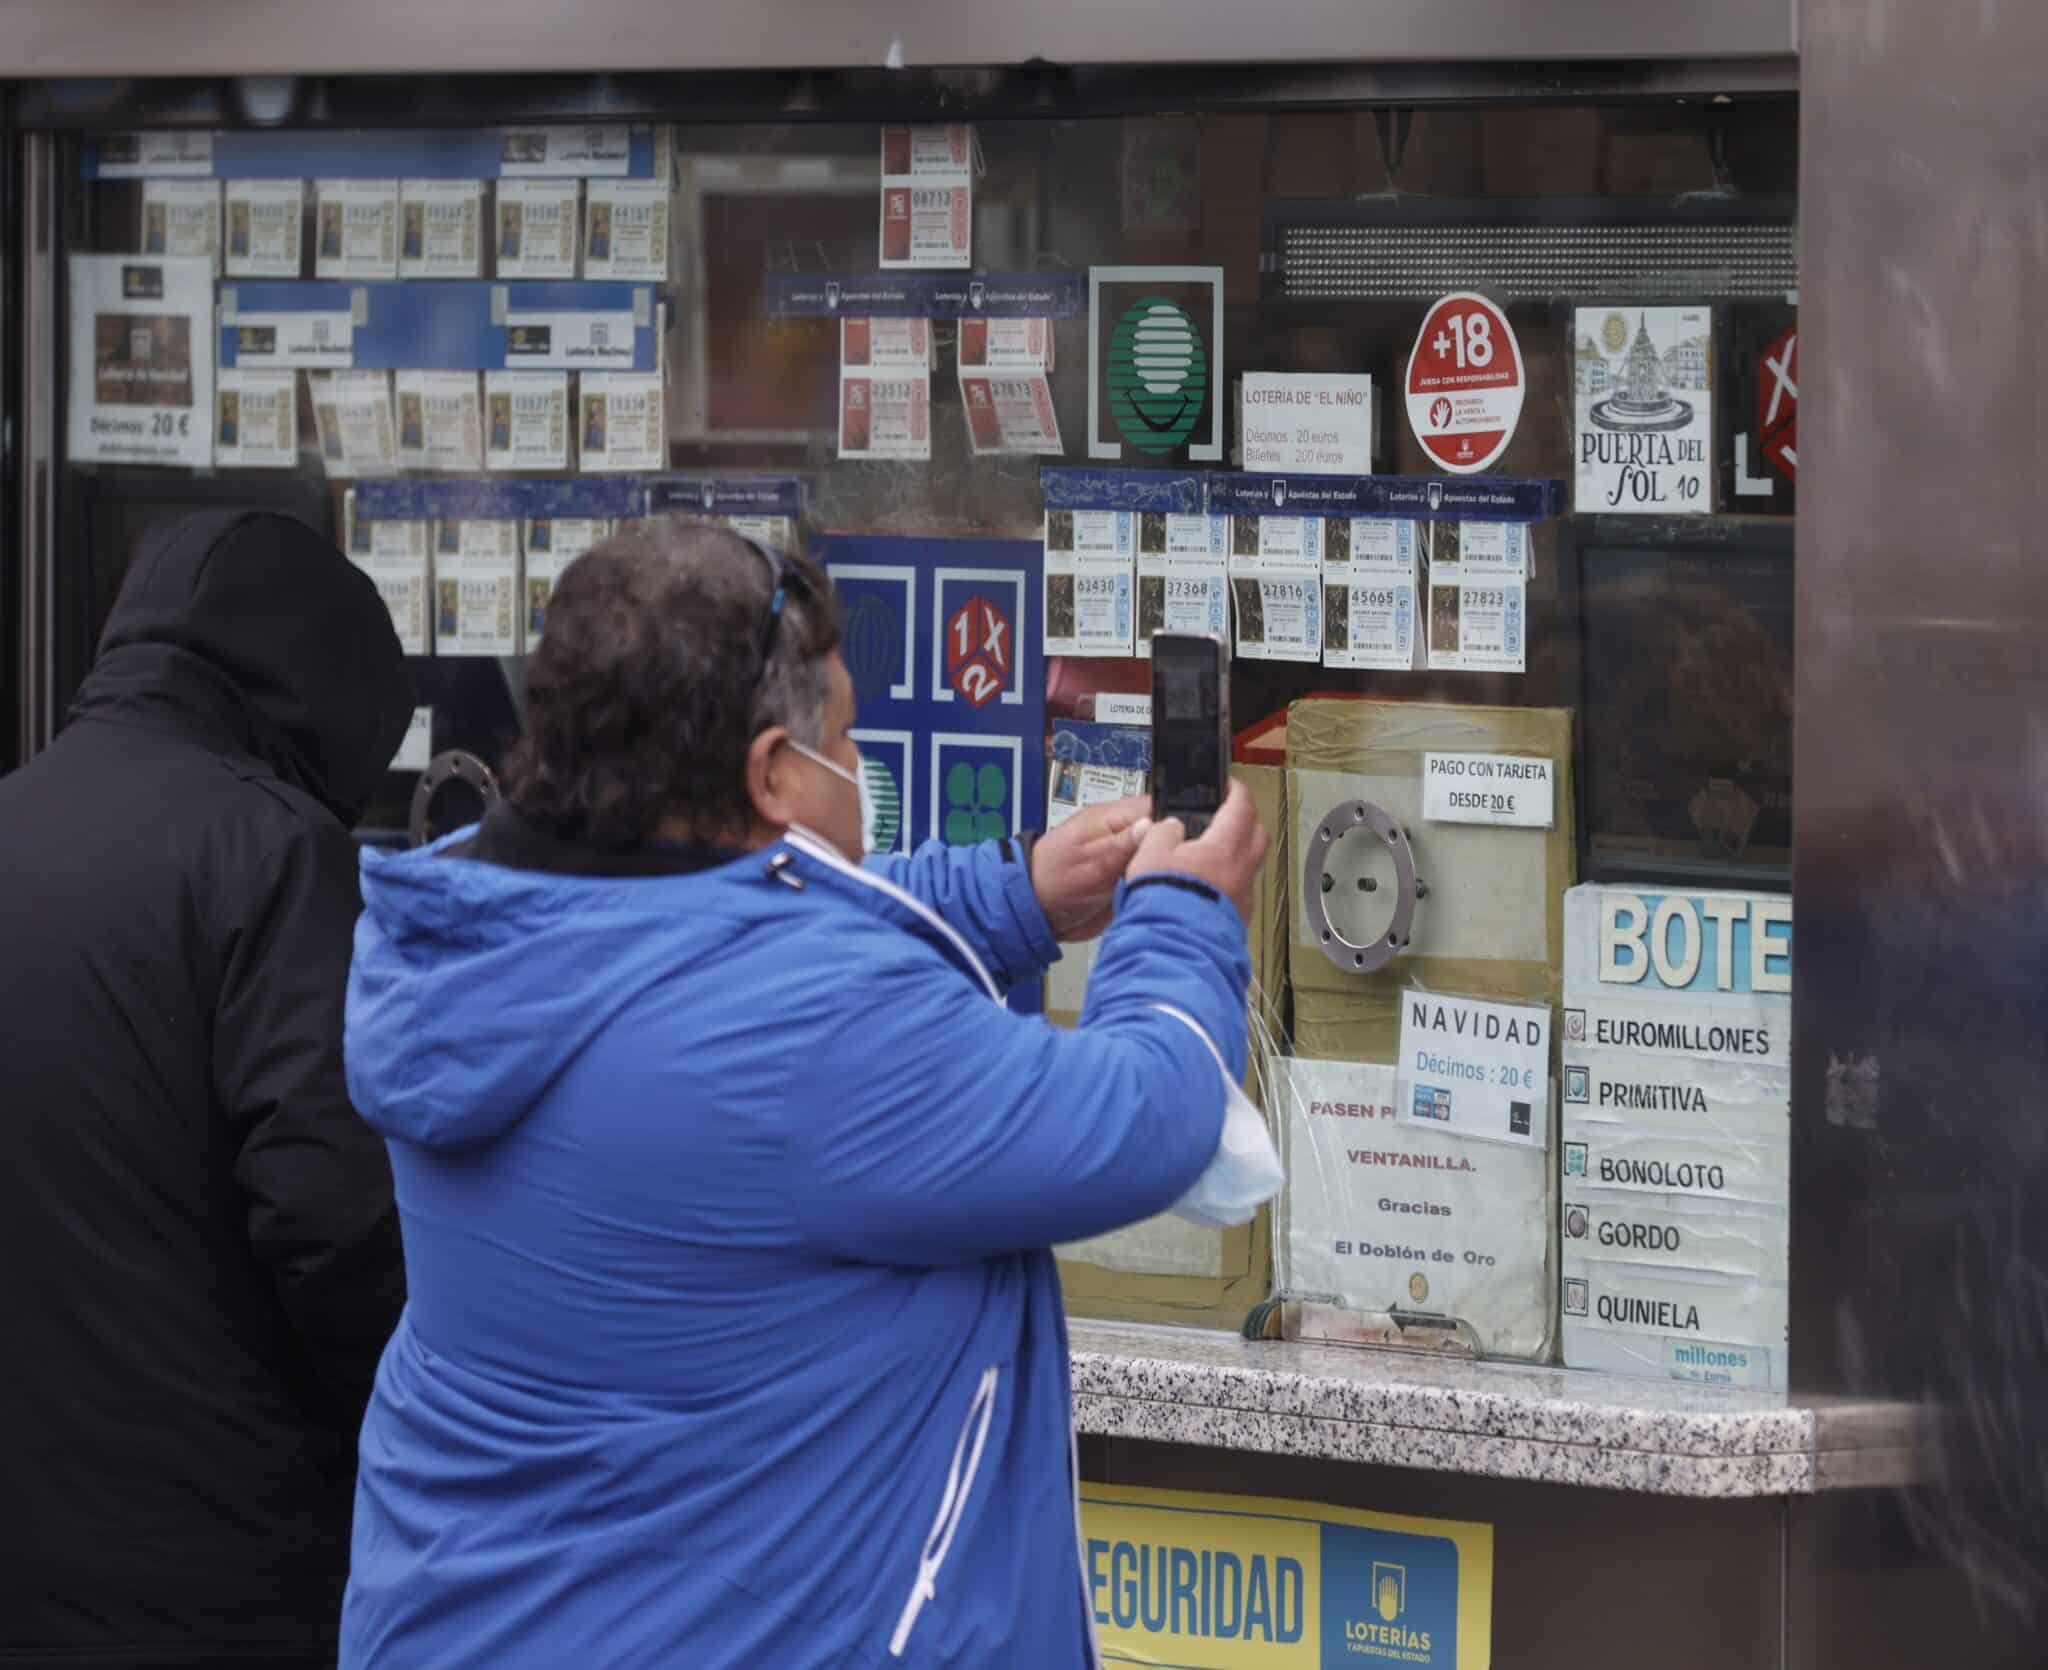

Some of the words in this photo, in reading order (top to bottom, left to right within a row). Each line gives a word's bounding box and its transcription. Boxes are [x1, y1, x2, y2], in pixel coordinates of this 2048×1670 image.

[1433, 313, 1493, 368] +18
[1296, 390, 1311, 405] DE
[151, 412, 173, 436] 20
[178, 413, 189, 436] €
[1296, 430, 1309, 443] 20
[1581, 433, 1675, 468] PUERTA
[1678, 439, 1705, 462] DEL
[1608, 465, 1666, 506] SOL
[1677, 475, 1700, 501] 10
[1167, 581, 1208, 595] 37368
[1463, 591, 1503, 606] 27823
[1431, 759, 1465, 775] PAGO
[1468, 761, 1493, 777] CON
[1496, 763, 1546, 780] TARJETA
[1449, 792, 1487, 808] DESDE
[1490, 794, 1504, 810] 20
[1507, 795, 1515, 811] €
[1599, 894, 1792, 994] BOTE
[1412, 1001, 1541, 1046] NAVIDAD
[1597, 1018, 1770, 1055] EUROMILLONES
[1416, 1050, 1485, 1081] Décimos
[1500, 1065, 1519, 1087] 20
[1523, 1069, 1534, 1090] €
[1310, 1101, 1374, 1118] PASEN
[1381, 1105, 1397, 1120] P
[1600, 1082, 1707, 1113] PRIMITIVA
[1347, 1149, 1477, 1172] VENTANILLA.
[1600, 1157, 1724, 1190] BONOLOTO
[1377, 1198, 1452, 1217] Gracias
[1598, 1221, 1680, 1251] GORDO
[1335, 1240, 1352, 1255] El
[1359, 1242, 1426, 1262] Doblón
[1432, 1248, 1454, 1263] de
[1463, 1251, 1496, 1267] Oro
[1598, 1295, 1700, 1330] QUINIELA
[1675, 1344, 1747, 1367] millones
[1085, 1538, 1305, 1644] EGURIDAD
[1346, 1620, 1431, 1651] LOTERÍAS
[1388, 1649, 1401, 1659] DEL
[1402, 1651, 1431, 1664] ESTADO
